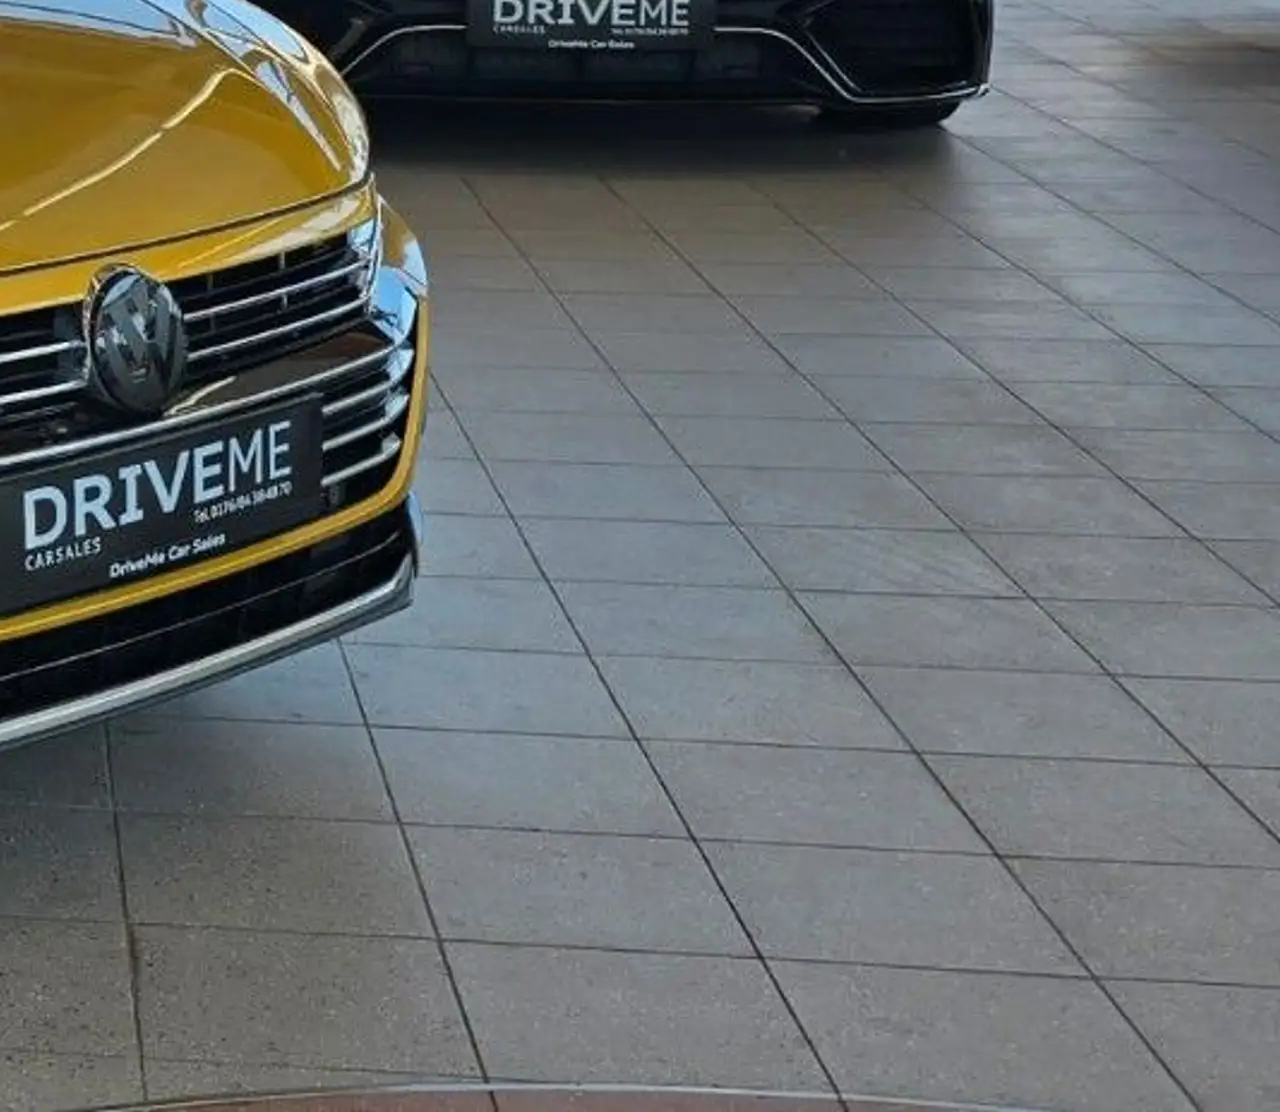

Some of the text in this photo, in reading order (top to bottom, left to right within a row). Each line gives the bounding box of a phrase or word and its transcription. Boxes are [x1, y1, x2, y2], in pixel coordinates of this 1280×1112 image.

[23, 420, 292, 550] DRIVEME
[24, 536, 101, 571] CARSALES
[109, 533, 226, 578] DriveMe Car Sales
